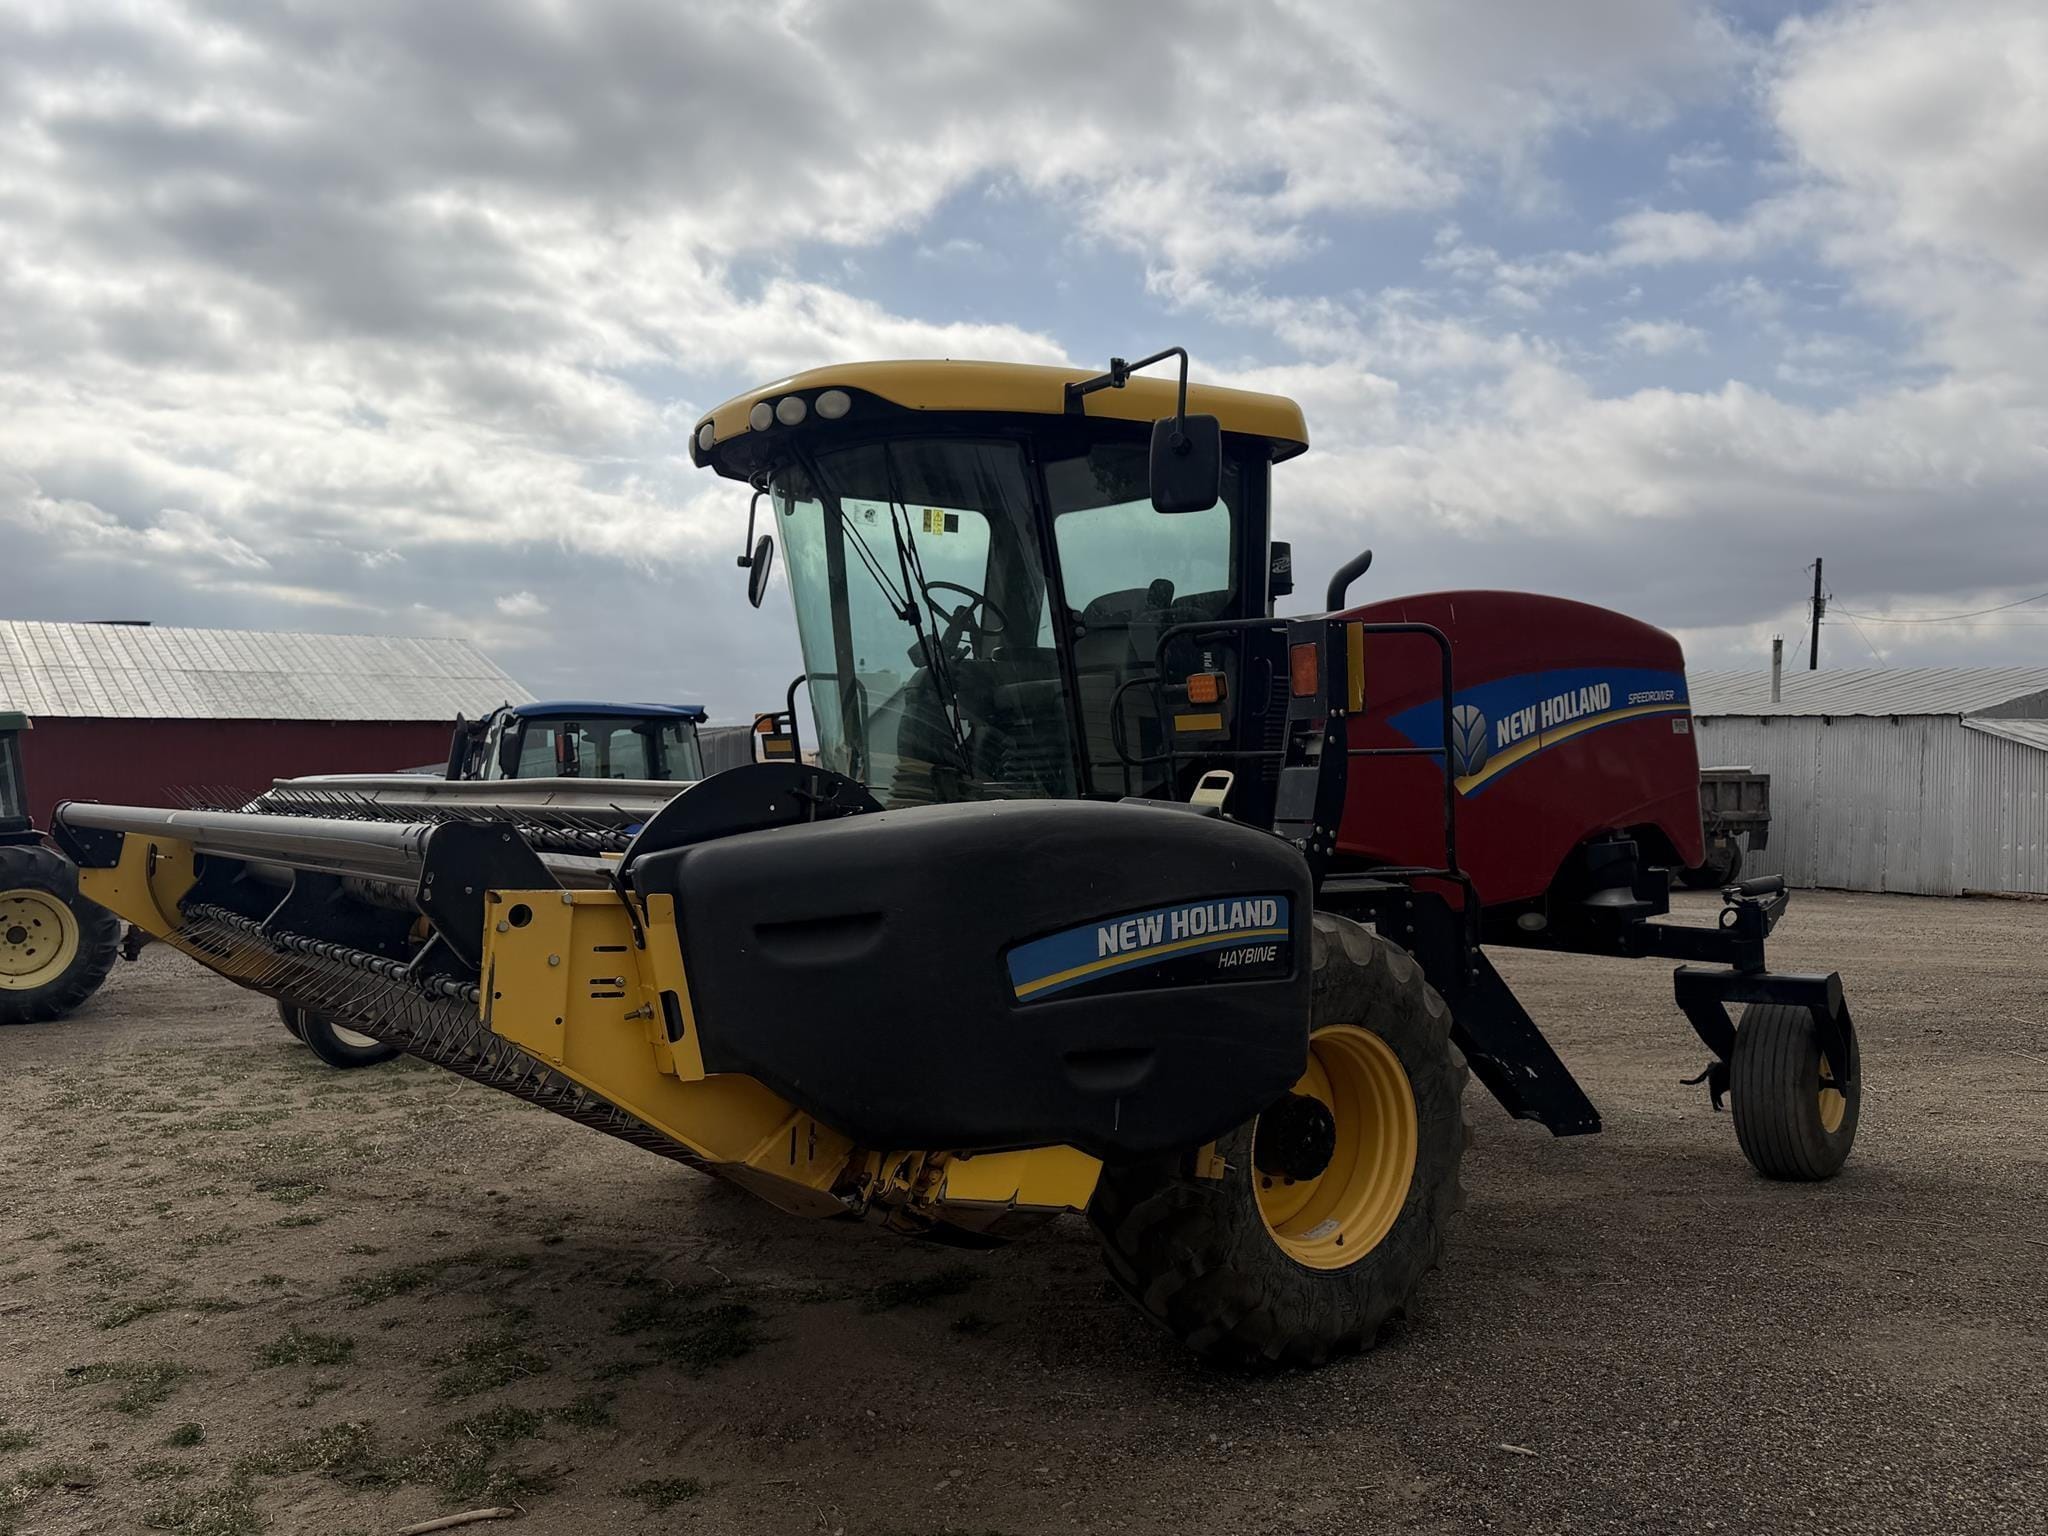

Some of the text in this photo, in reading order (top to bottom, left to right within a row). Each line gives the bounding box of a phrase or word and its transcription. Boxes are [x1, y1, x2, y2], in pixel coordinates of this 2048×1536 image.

[1497, 682, 1674, 748] NEW HOLLAND SPEEDROWER
[1097, 899, 1277, 957] NEW HOLLAND
[1218, 946, 1277, 969] HAYBINE
